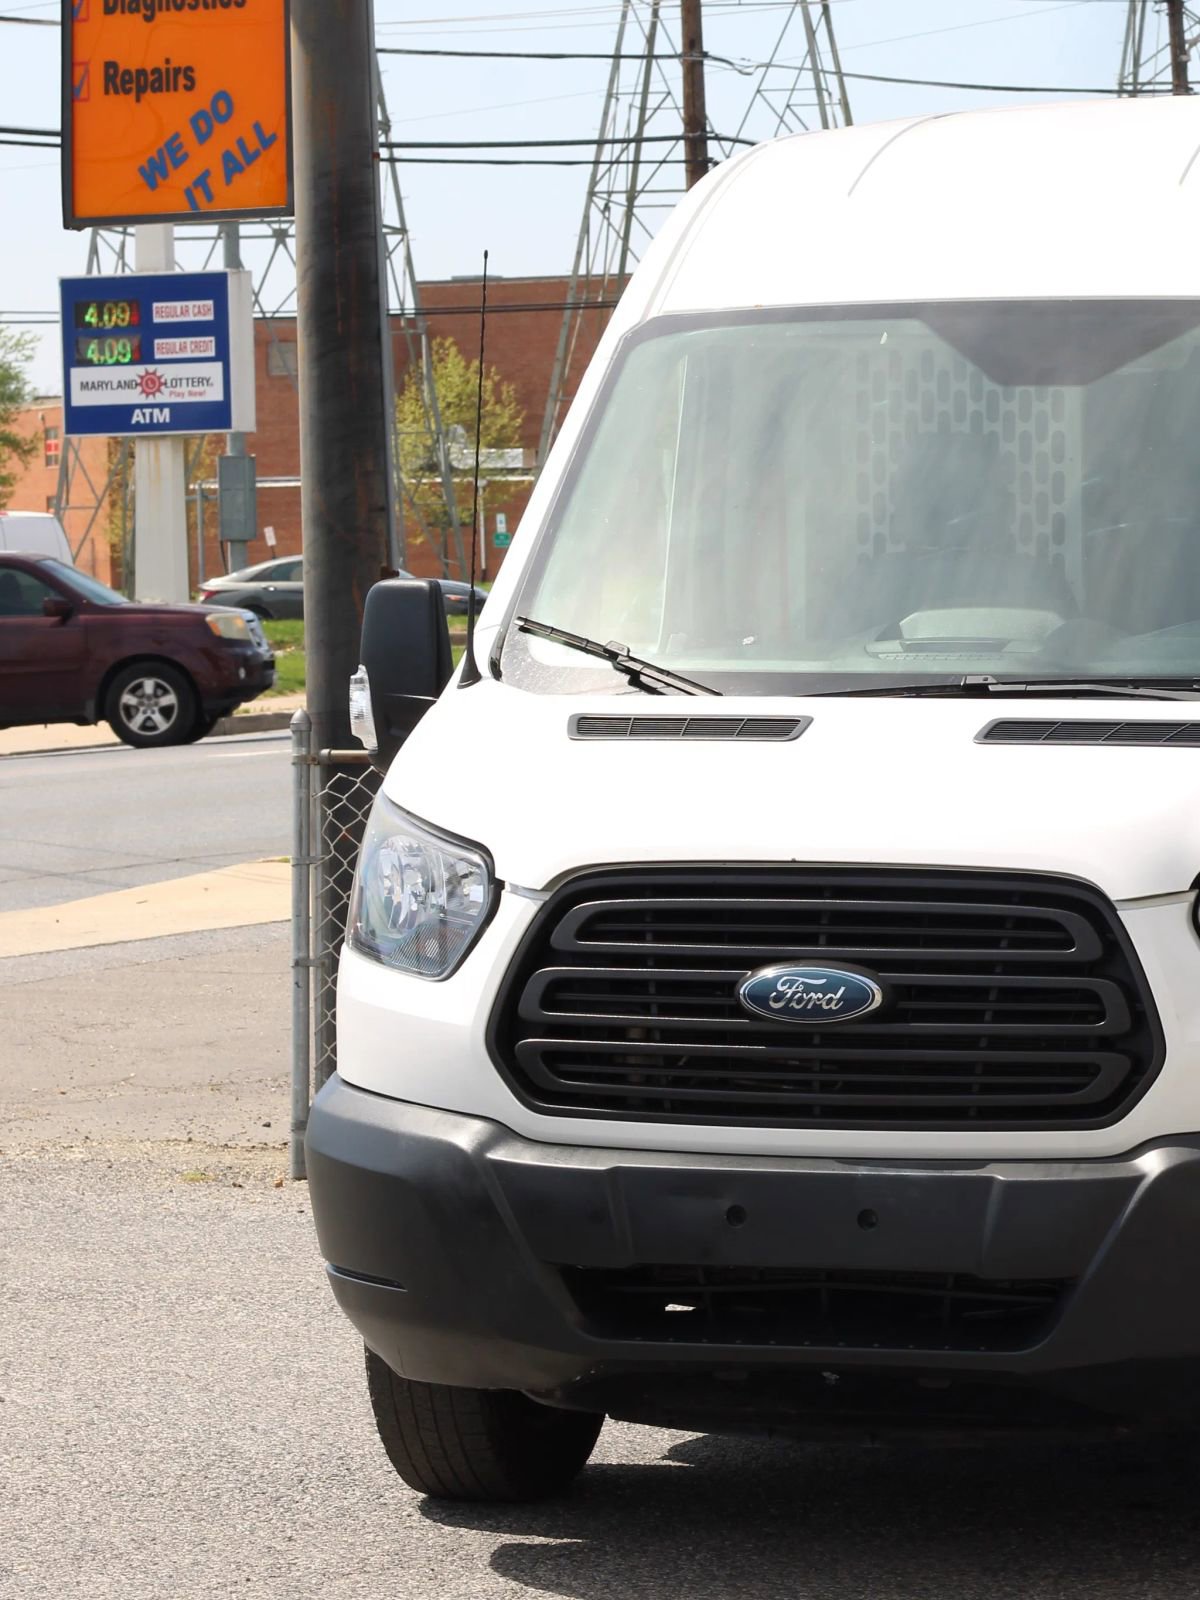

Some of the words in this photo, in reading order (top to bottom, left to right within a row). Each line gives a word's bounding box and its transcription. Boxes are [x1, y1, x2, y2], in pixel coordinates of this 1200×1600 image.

[103, 0, 246, 23] agnoscs
[103, 58, 196, 103] Repairs
[137, 131, 189, 191] WE
[189, 90, 234, 145] DO
[183, 169, 214, 212] IT
[221, 120, 278, 186] ALL
[155, 304, 190, 318] REGULAR
[192, 303, 212, 317] CASH
[156, 341, 189, 354] REGULAR
[190, 339, 213, 353] CREDIT
[80, 379, 137, 392] MARYLAND
[169, 390, 185, 398] Play
[131, 407, 170, 424] ATM
[769, 976, 846, 1009] Ford
